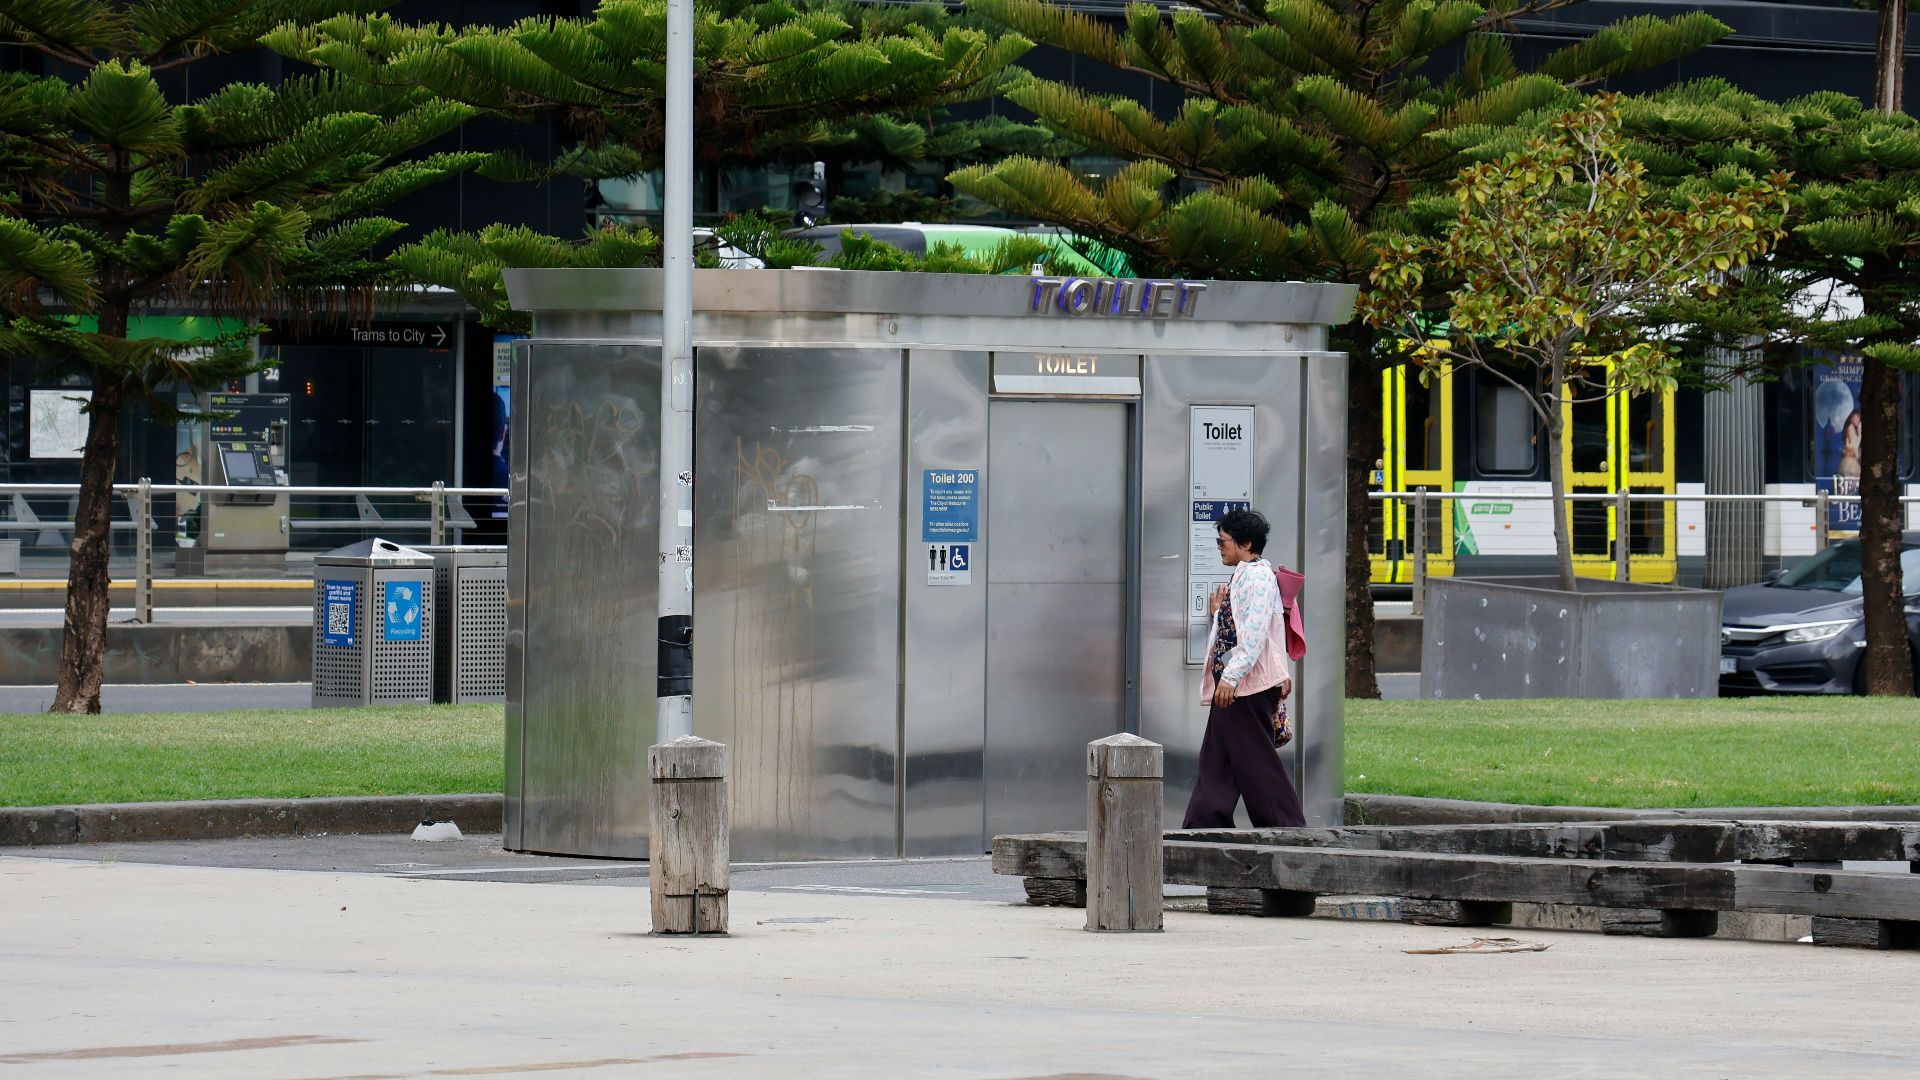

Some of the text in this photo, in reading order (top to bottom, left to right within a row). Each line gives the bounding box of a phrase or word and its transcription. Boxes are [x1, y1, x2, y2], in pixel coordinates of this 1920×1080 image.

[1031, 277, 1207, 317] TOILET
[351, 328, 425, 345] Trams to City
[1035, 354, 1099, 374] TOILET
[1203, 422, 1242, 440] Toilet
[930, 472, 975, 484] Toilet 200
[1194, 502, 1214, 511] Public
[1194, 511, 1211, 520] Toilet
[390, 628, 416, 636] Recycling
